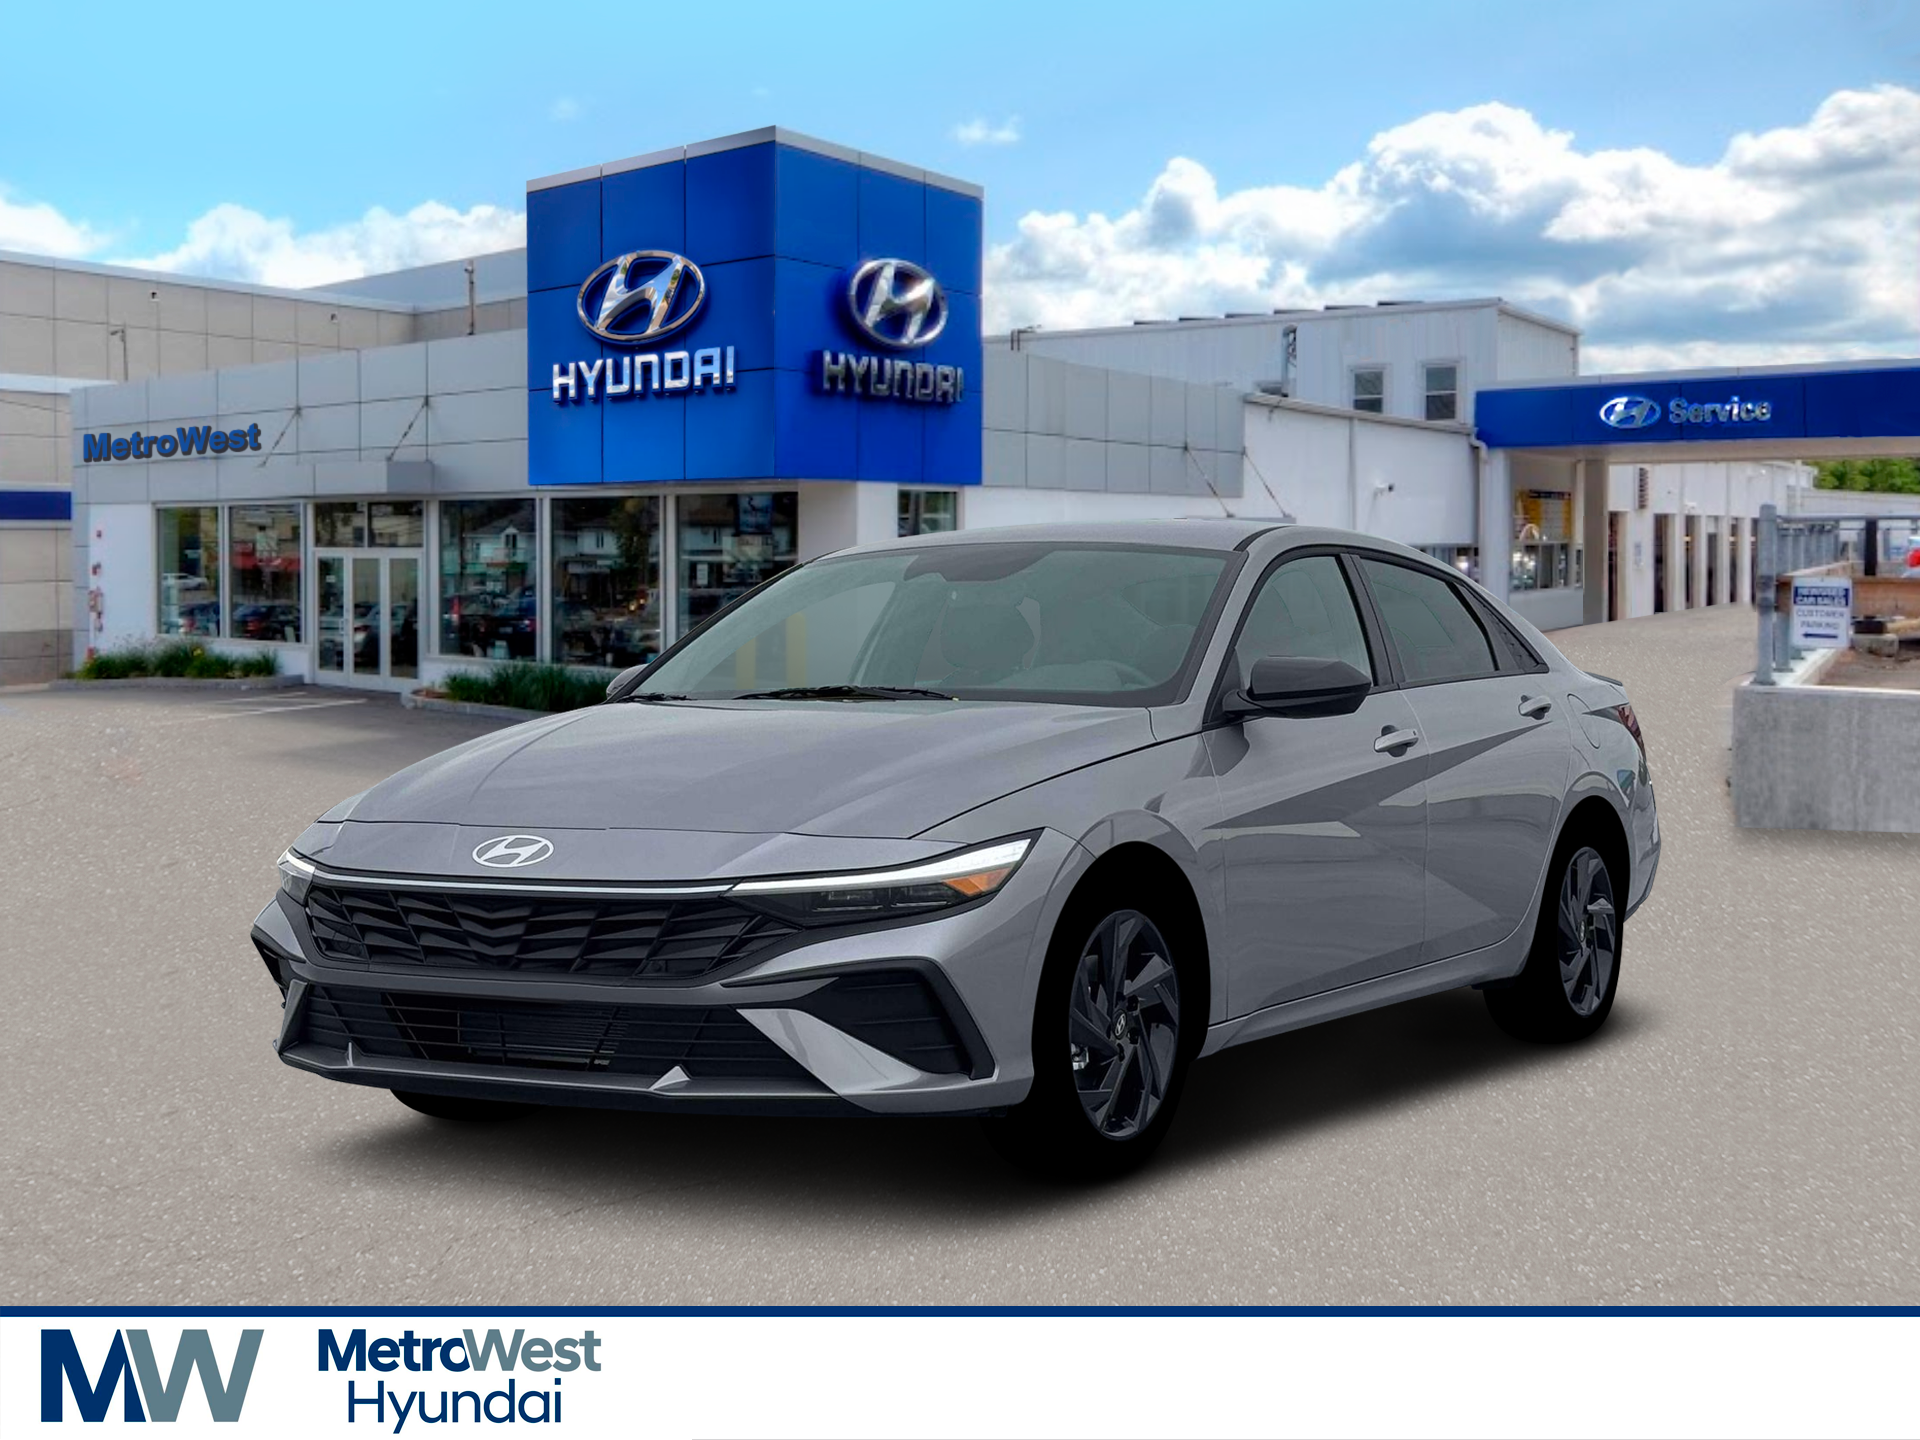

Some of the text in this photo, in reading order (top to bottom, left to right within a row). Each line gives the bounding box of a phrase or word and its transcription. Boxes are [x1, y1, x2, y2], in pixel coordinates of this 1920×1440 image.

[552, 345, 736, 401] HYUNDAI
[822, 350, 964, 402] HYUNDAI
[1668, 395, 1772, 424] Service
[83, 423, 261, 462] MetroWest
[1796, 609, 1845, 618] CUSTOMER
[1800, 622, 1840, 630] PARKING
